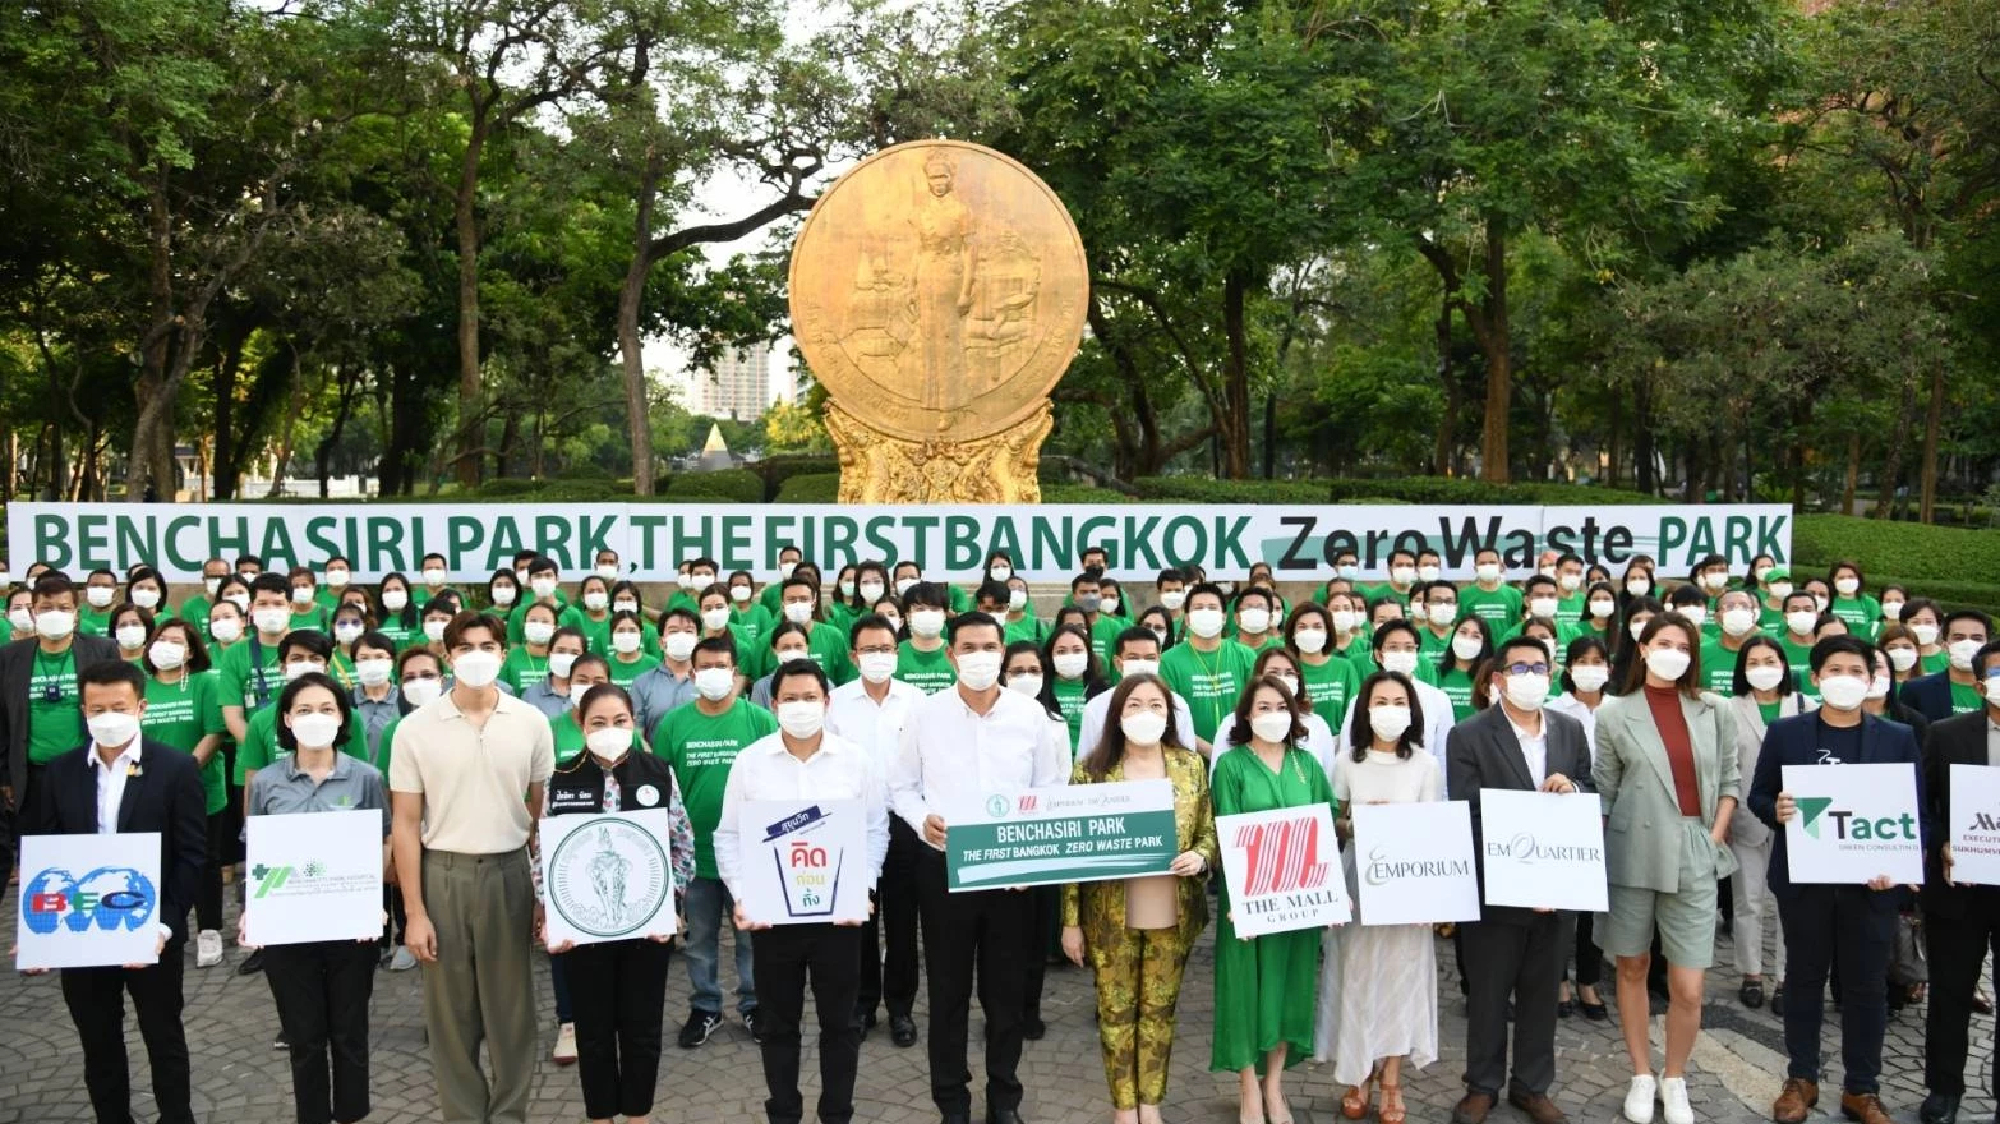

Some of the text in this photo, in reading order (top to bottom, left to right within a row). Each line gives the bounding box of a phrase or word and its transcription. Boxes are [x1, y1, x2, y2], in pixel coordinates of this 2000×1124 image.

[34, 514, 424, 572] BENCHASIRI
[765, 515, 939, 571] FIRST
[945, 515, 1252, 571] BANGKOK
[1438, 516, 1634, 569] Waste
[1657, 515, 1788, 567] PARK
[996, 816, 1125, 843] BENCHASIRI PARK
[1828, 810, 1917, 840] Tact
[791, 842, 827, 867] คิด
[963, 835, 1163, 862] THE FIRST BANGKOK ZERO WASTE PARK
[1373, 860, 1470, 878] EMPORIUM
[1242, 889, 1339, 915] THE MALL
[1266, 908, 1319, 923] GROUP
